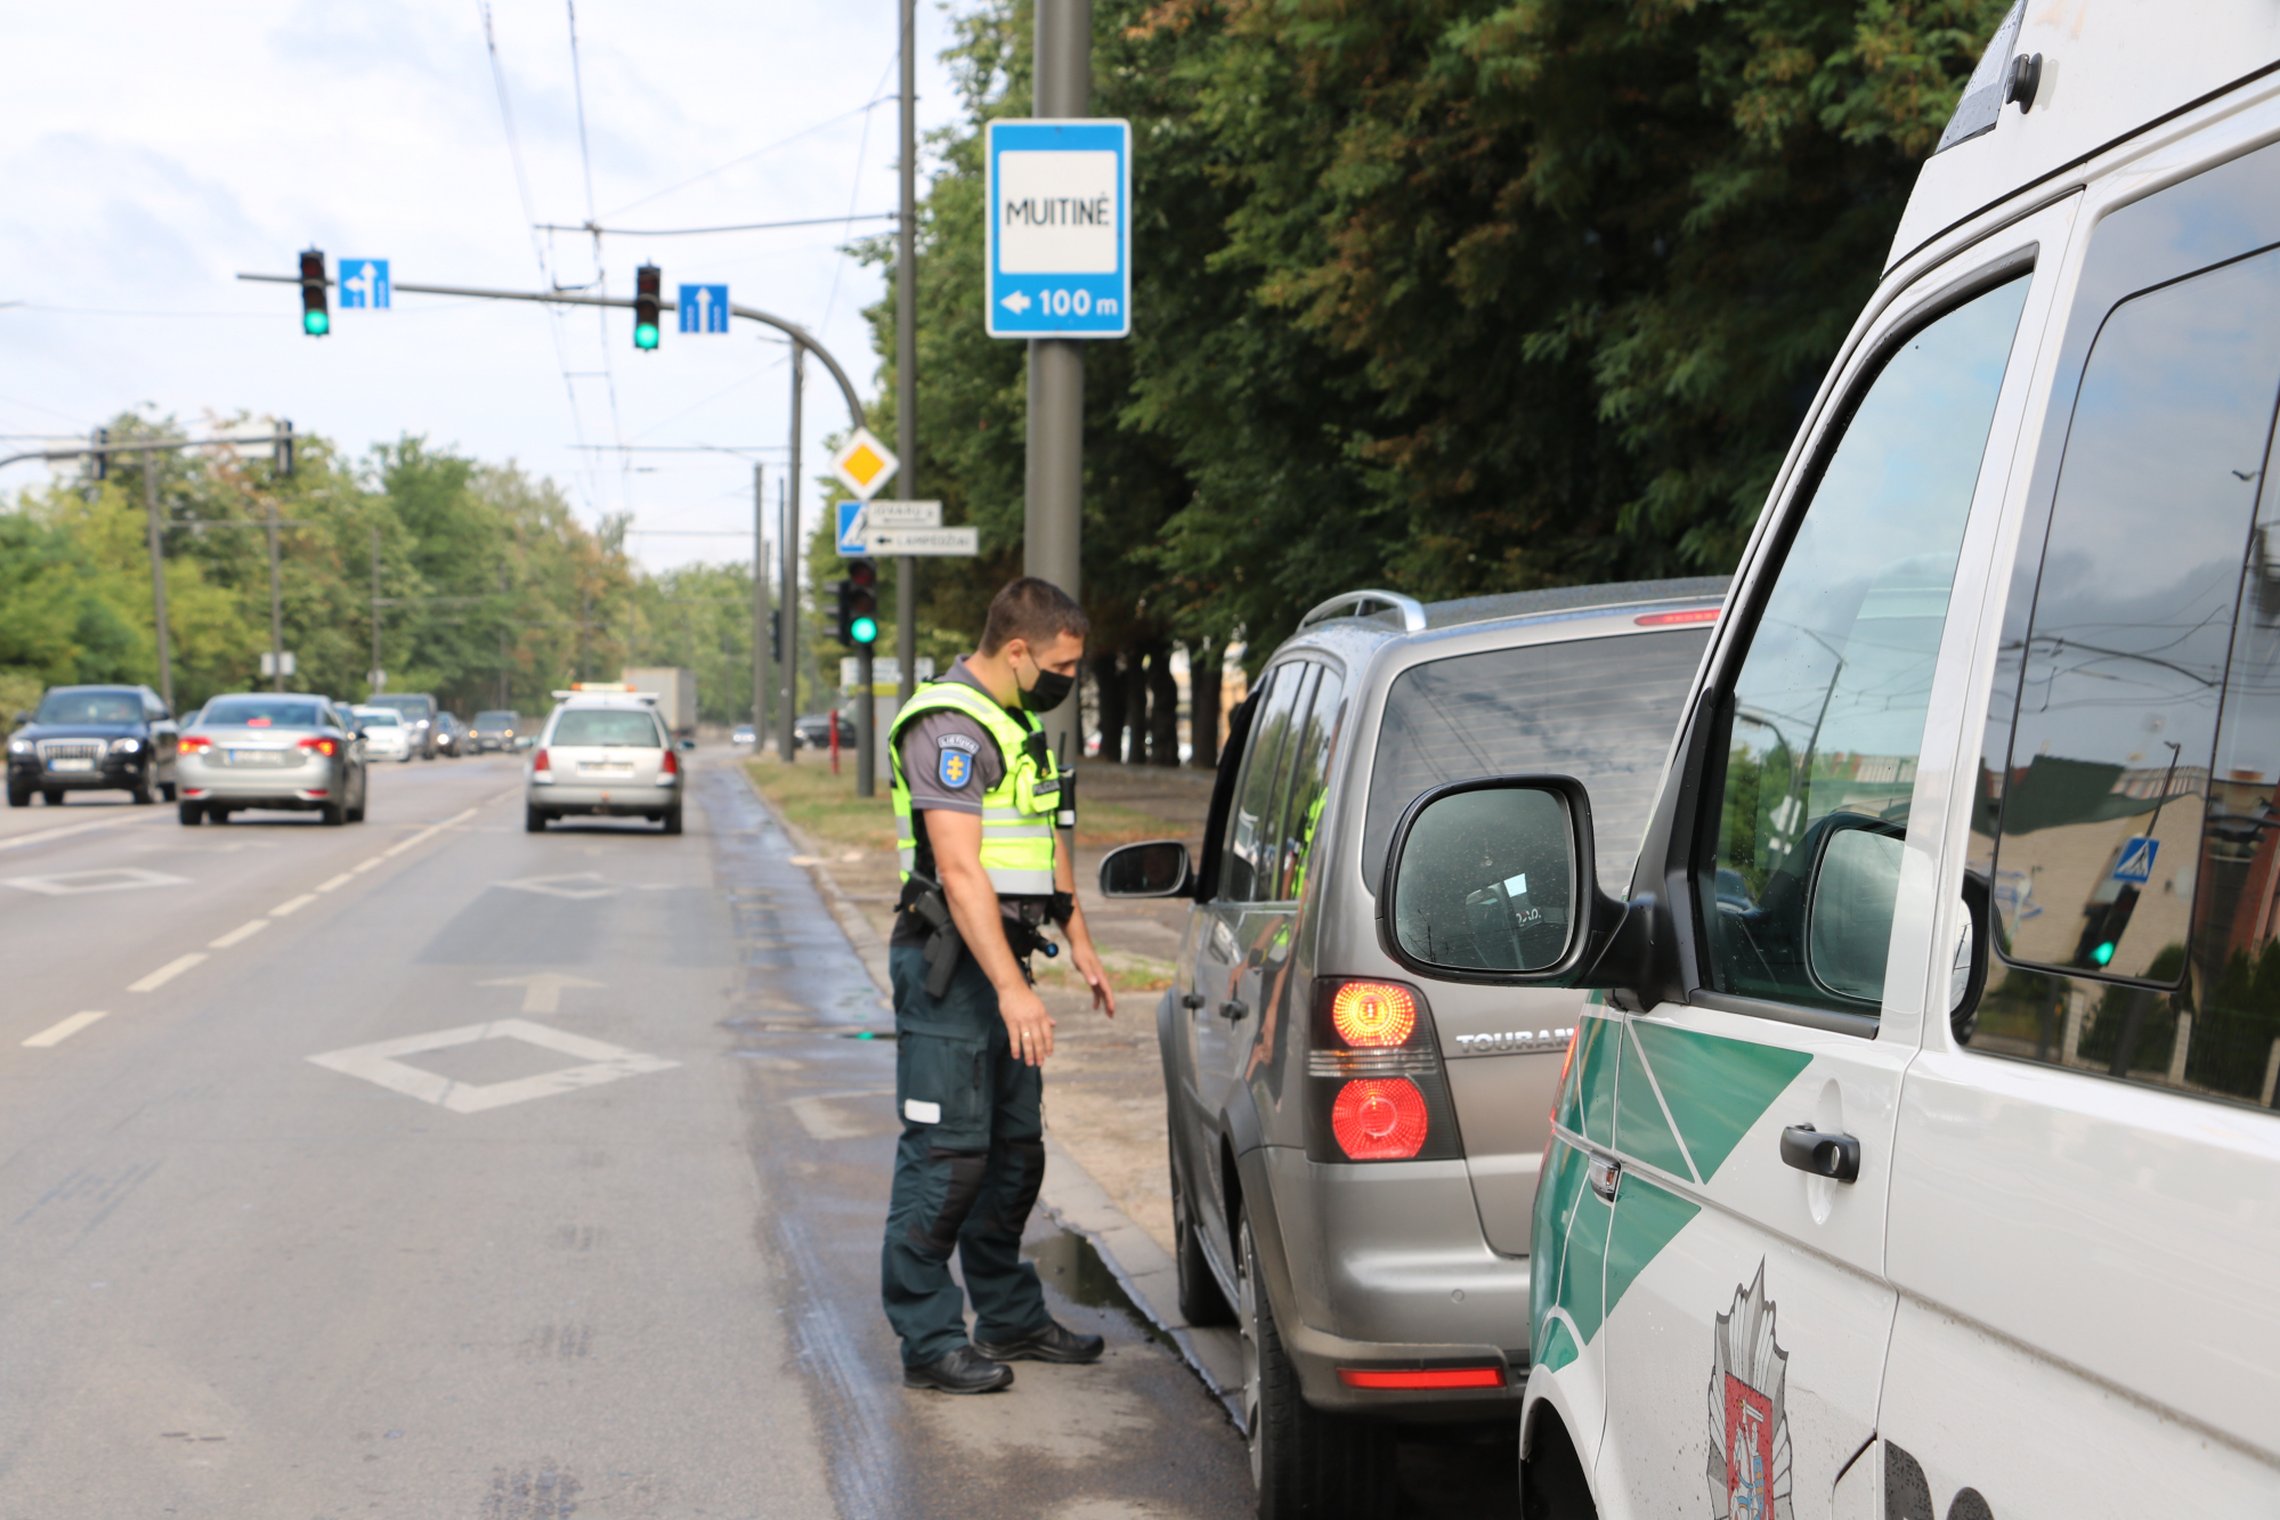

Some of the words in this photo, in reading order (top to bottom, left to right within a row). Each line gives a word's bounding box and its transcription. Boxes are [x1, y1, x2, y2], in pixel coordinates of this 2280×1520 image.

[1006, 192, 1109, 225] MUITINĖ
[1040, 289, 1091, 316] 100
[1097, 298, 1118, 316] m
